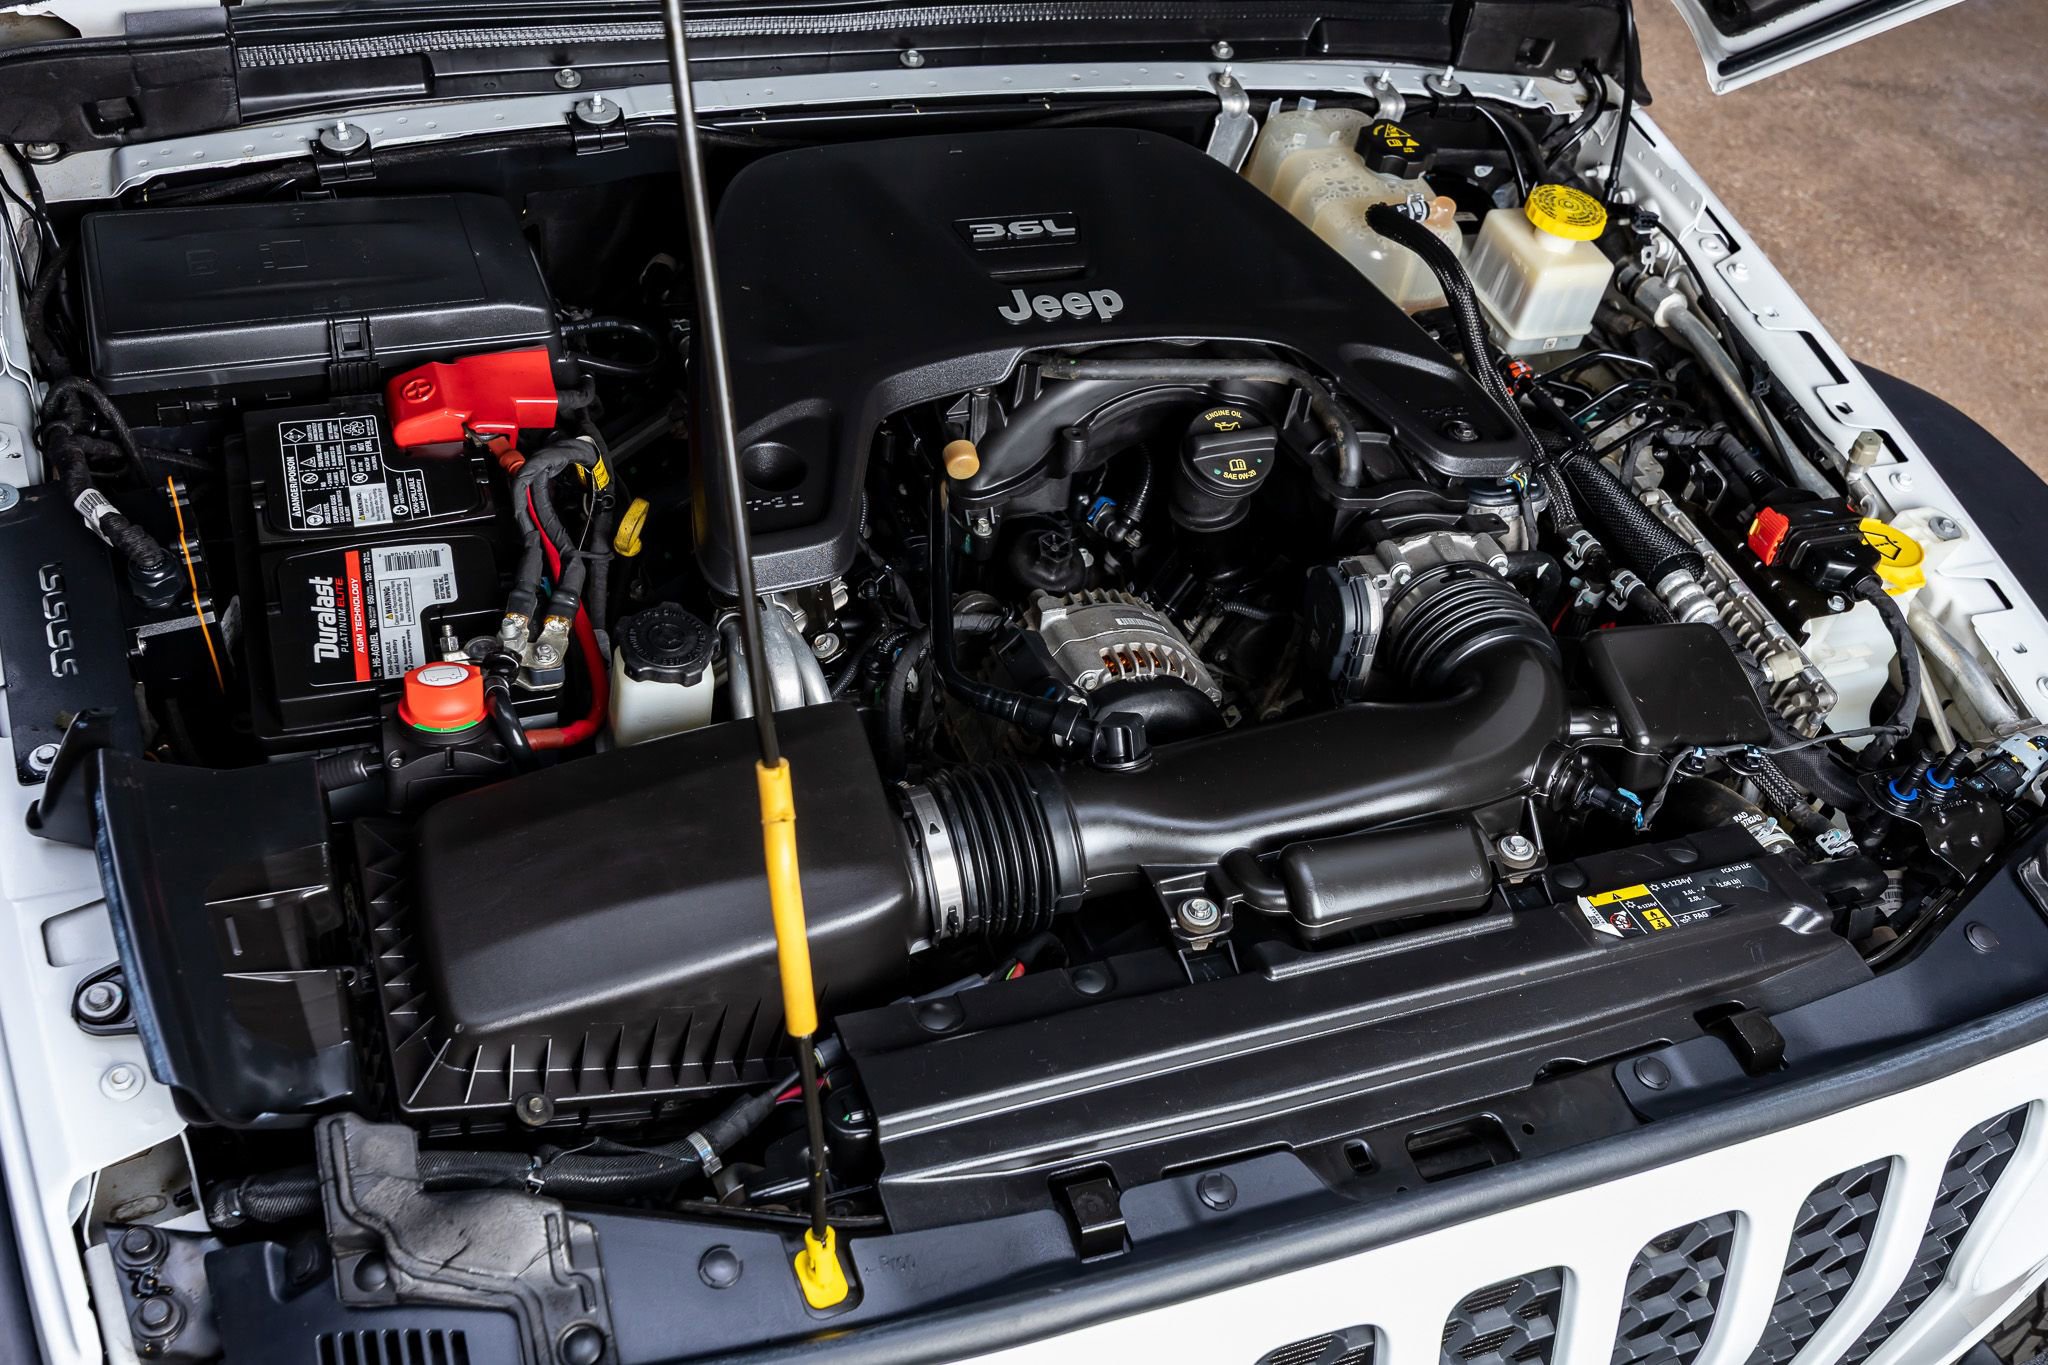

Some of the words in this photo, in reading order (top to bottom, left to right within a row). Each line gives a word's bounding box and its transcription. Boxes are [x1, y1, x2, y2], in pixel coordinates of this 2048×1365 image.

[969, 219, 1076, 242] 3.6L
[998, 289, 1124, 325] Jeep
[1204, 409, 1230, 421] ENGINE
[1231, 410, 1243, 418] OIL
[286, 456, 300, 511] DANGER/POISON
[1223, 471, 1237, 479] SAE
[1238, 469, 1256, 479] 0W-20
[407, 477, 420, 513] NON-SPILLABLE
[335, 576, 345, 607] ELITE
[351, 577, 363, 631] TECHNOLOGY
[309, 576, 340, 663] Duralast
[340, 608, 349, 653] PLATINUM
[356, 633, 364, 653] AGM
[370, 632, 381, 667] H6-AGMEL
[1732, 811, 1749, 823] RAD
[1661, 876, 1693, 889] R-1234yf
[1693, 911, 1709, 920] PAG
